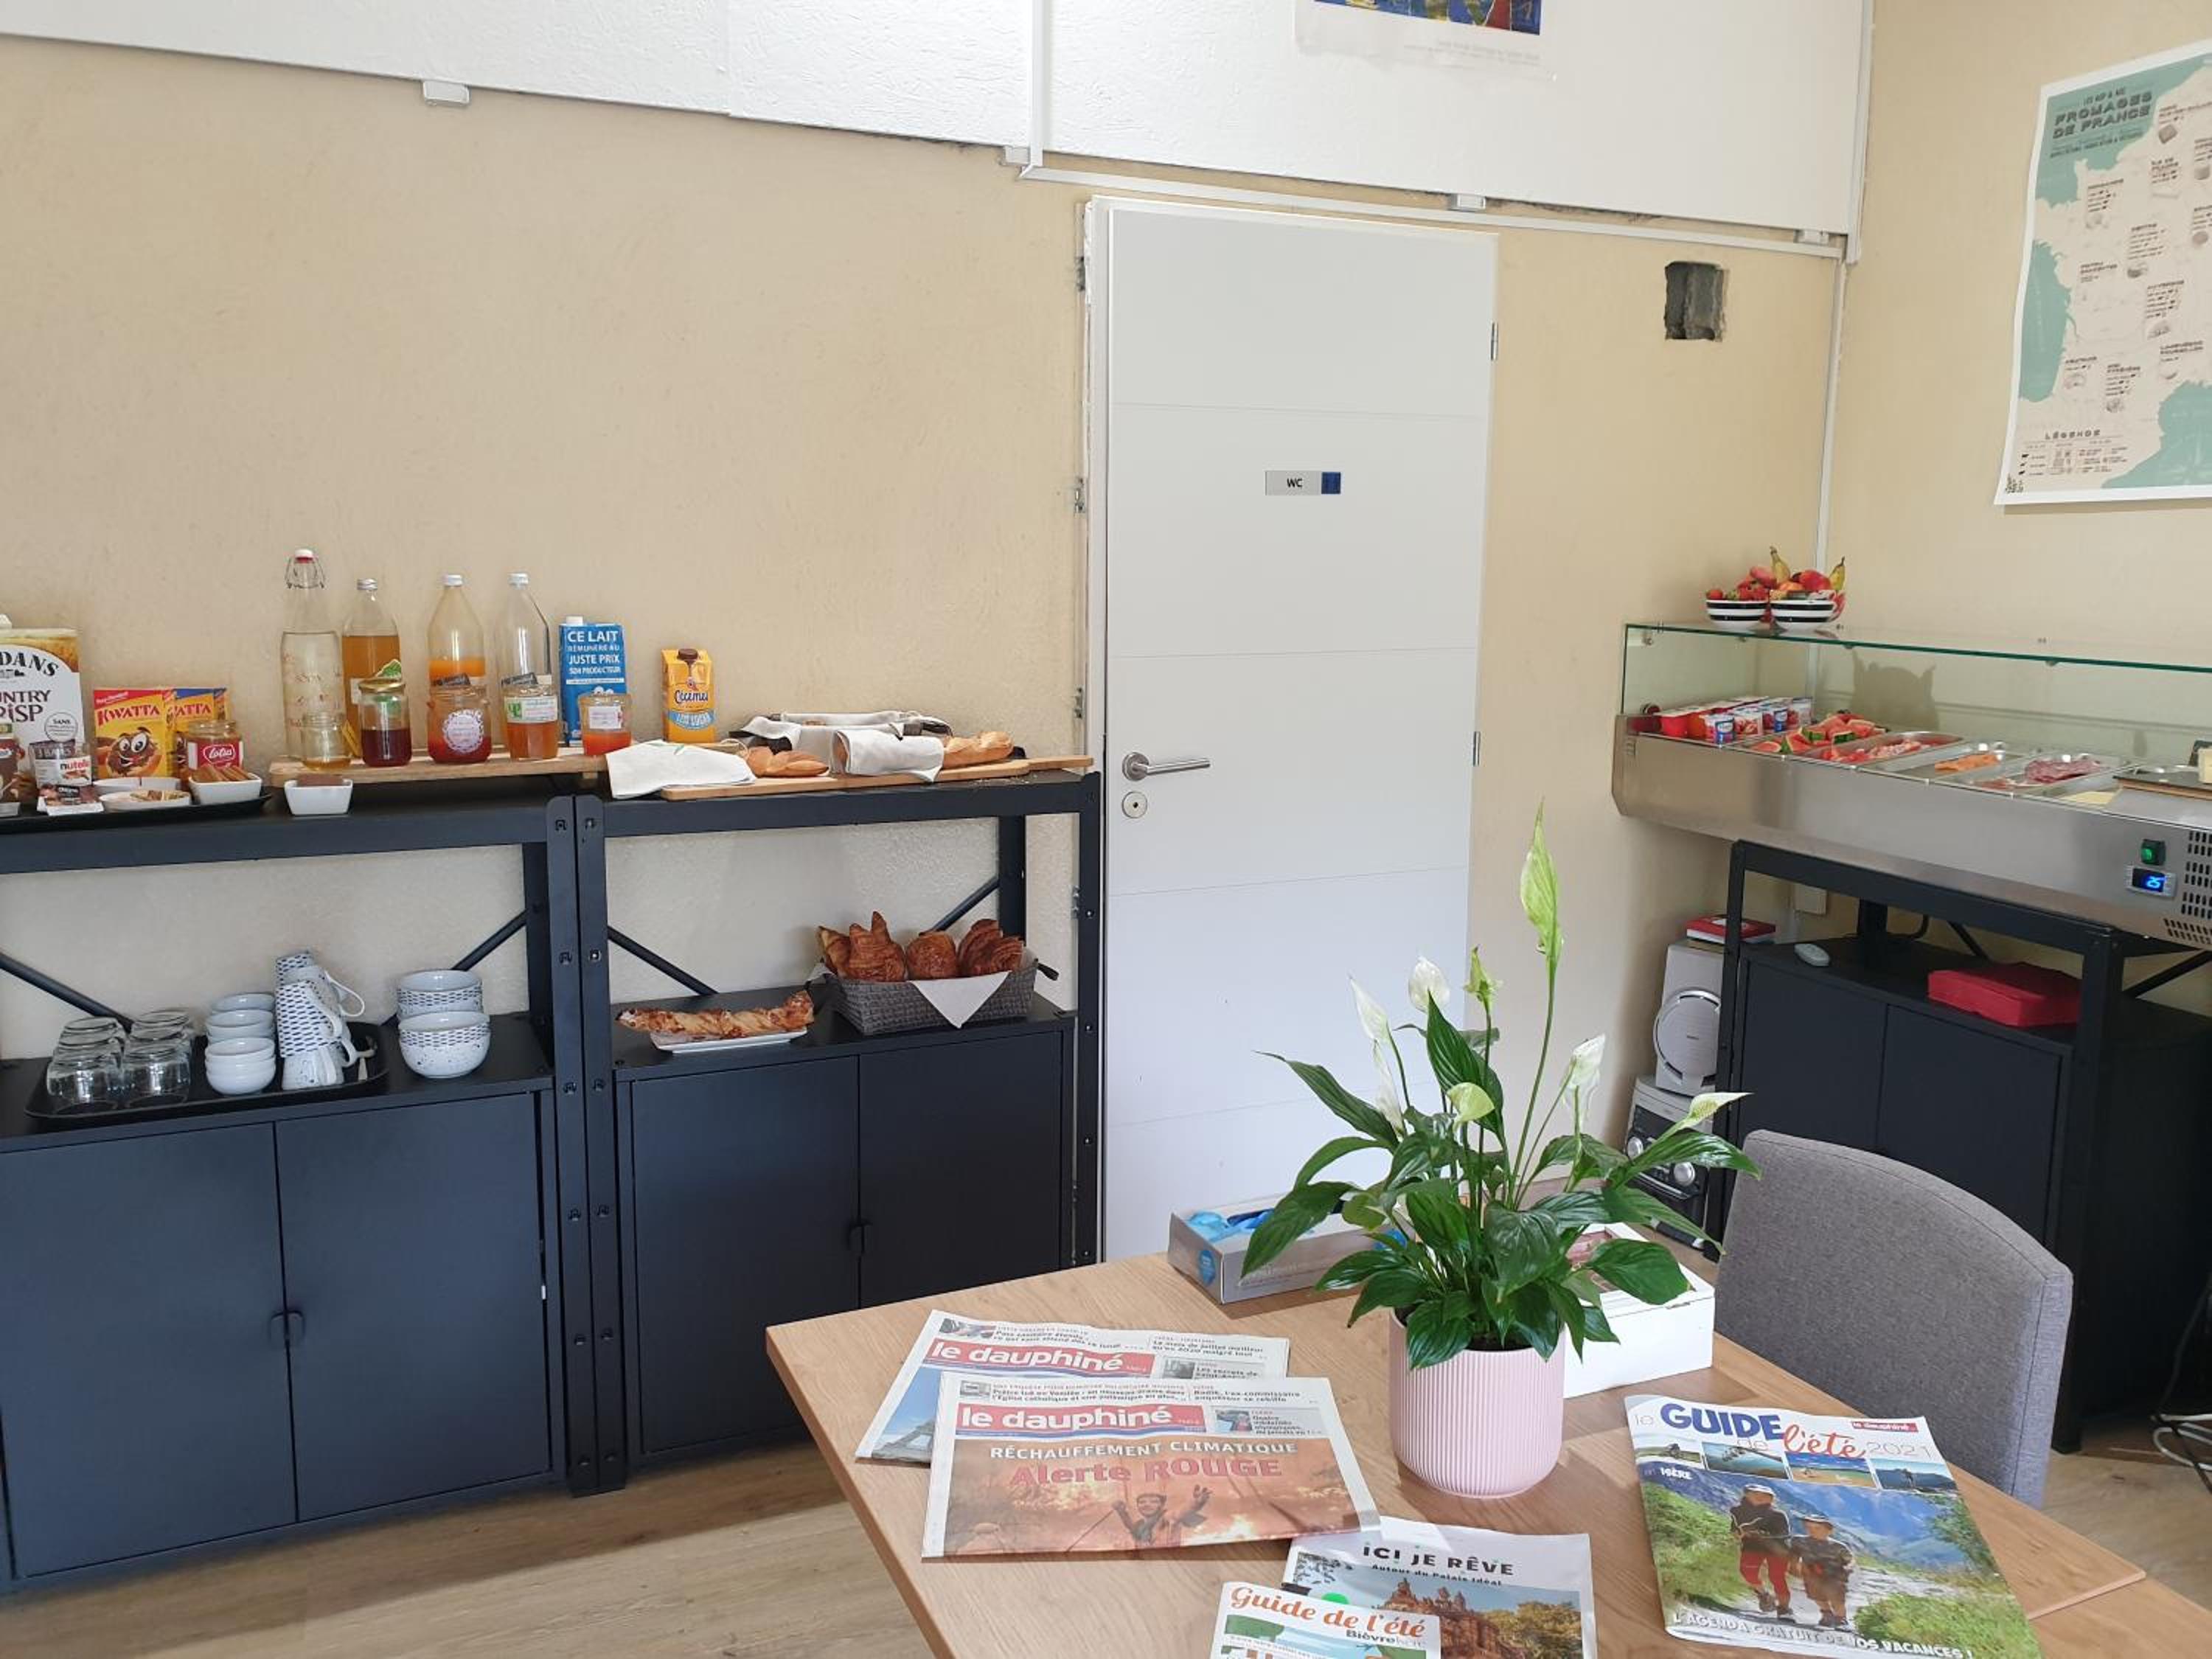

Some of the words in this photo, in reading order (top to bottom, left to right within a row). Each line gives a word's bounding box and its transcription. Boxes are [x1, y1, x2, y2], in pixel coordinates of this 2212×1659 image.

[1287, 477, 1303, 487] WC
[567, 630, 585, 642] CE
[588, 630, 619, 642] LAIT
[568, 654, 597, 665] JUSTE
[599, 653, 621, 664] PRIX
[97, 703, 161, 727] KWATTA
[208, 747, 233, 759] Lotus
[931, 1342, 962, 1359] le
[967, 1346, 1124, 1372] dauphiné
[961, 1406, 992, 1427] le
[1002, 1405, 1172, 1430] dauphiné
[1660, 1403, 1784, 1441] GUIDE
[990, 1441, 1163, 1461] RÉCHAUFFEMENT
[1170, 1440, 1298, 1455] CLIMATIQUE
[1783, 1424, 1867, 1458] l'été
[1866, 1441, 1933, 1459] 2021
[1009, 1461, 1133, 1488] Alerte
[1144, 1458, 1283, 1482] ROUGE
[1371, 1564, 1411, 1575] Autour
[1414, 1570, 1429, 1578] du
[1432, 1572, 1469, 1582] Palais
[1470, 1576, 1503, 1586] Idéal
[1411, 1553, 1437, 1567] JE
[1447, 1556, 1514, 1576] RÊVE
[1231, 1585, 1317, 1621] Guide
[1323, 1609, 1360, 1629] de
[1366, 1613, 1426, 1638] l'été
